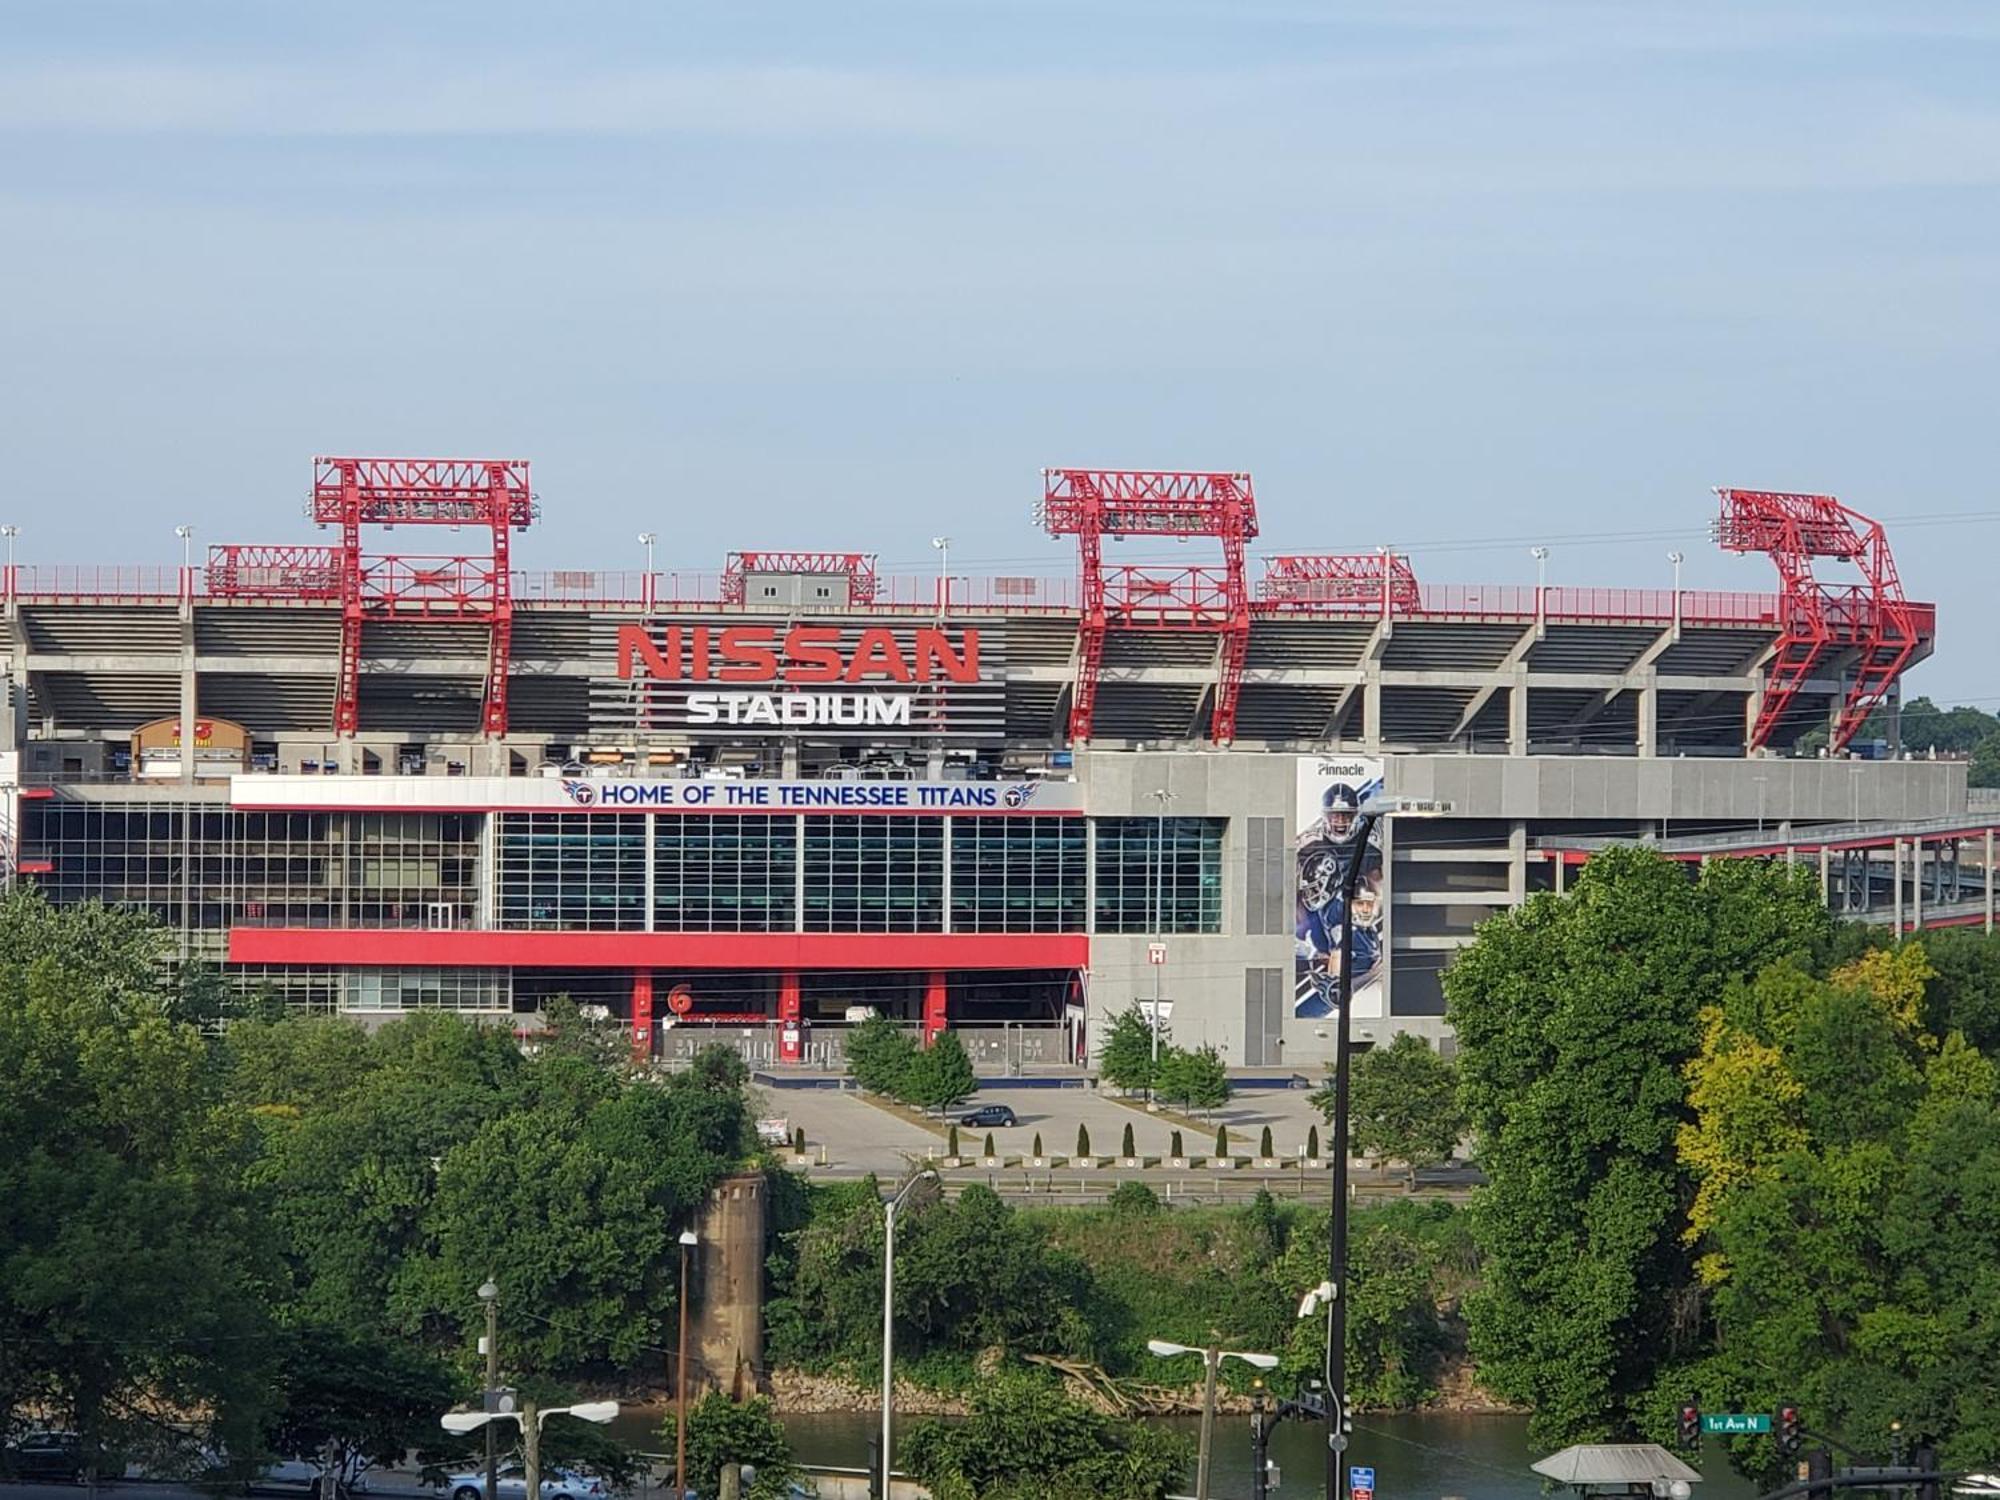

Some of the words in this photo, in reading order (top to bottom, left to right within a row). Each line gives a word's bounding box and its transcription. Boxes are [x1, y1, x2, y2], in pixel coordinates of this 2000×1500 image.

[618, 626, 980, 683] NISSAN
[686, 694, 911, 726] STADIUM
[1318, 763, 1365, 776] Pinnacle
[602, 786, 673, 804] HOME
[683, 786, 716, 804] OF
[725, 787, 768, 805] THE
[778, 787, 908, 806] TENNESSEE
[917, 788, 997, 806] TITANS
[1151, 950, 1164, 963] H
[1709, 1417, 1723, 1429] 1st
[1725, 1417, 1746, 1429] Ave
[1747, 1417, 1758, 1429] N
